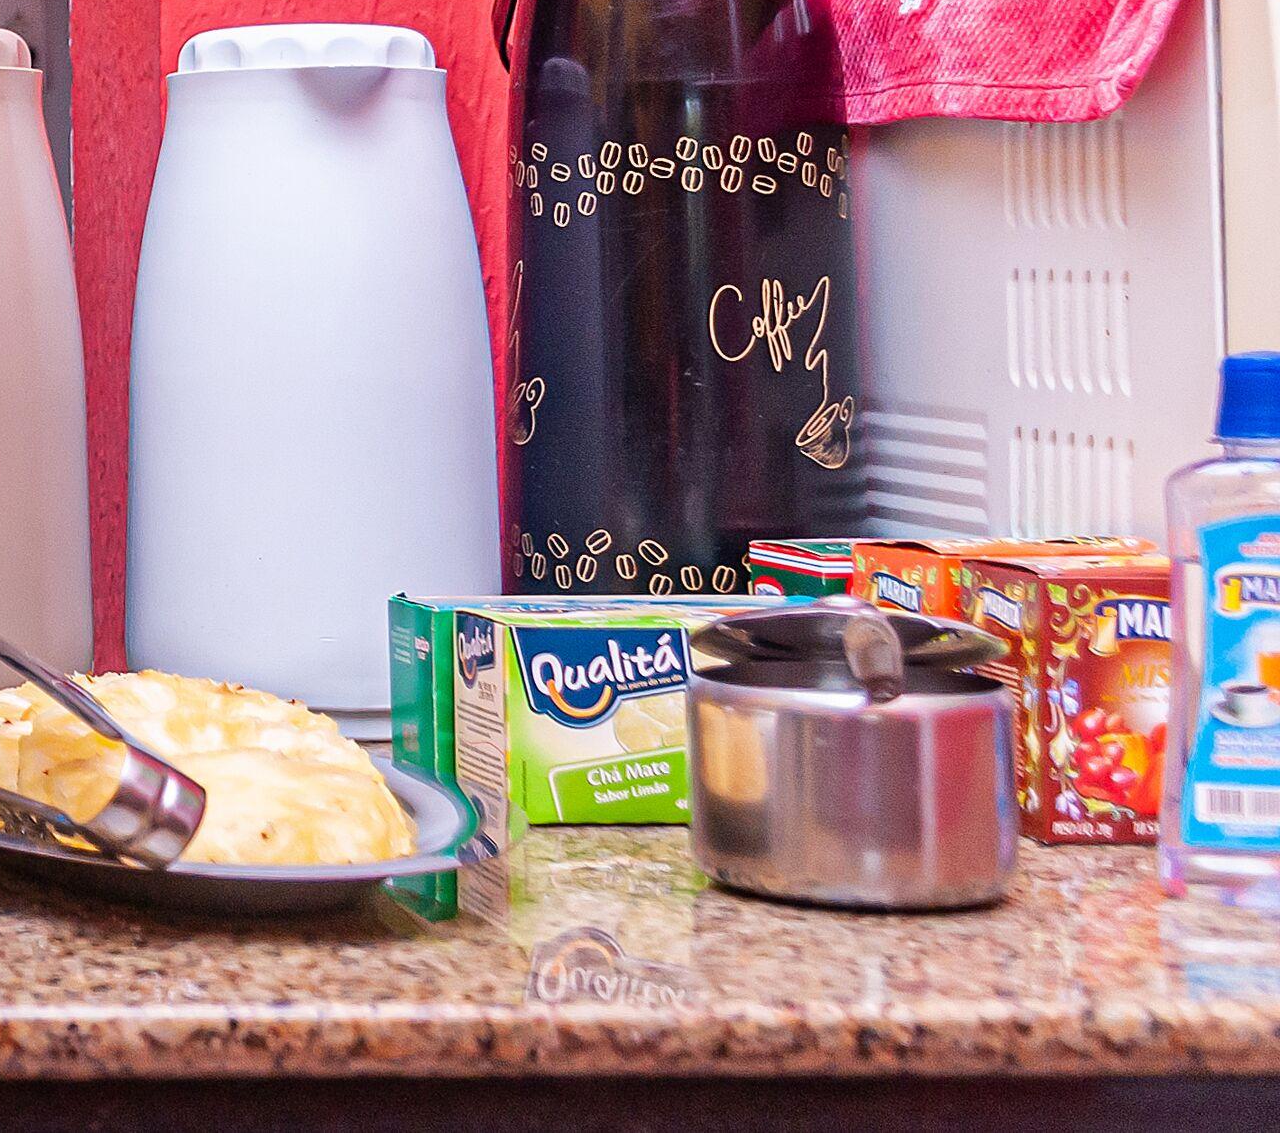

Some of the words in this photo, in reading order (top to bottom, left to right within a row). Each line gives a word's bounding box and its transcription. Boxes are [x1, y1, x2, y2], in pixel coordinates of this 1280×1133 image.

[709, 278, 814, 372] Coffee
[531, 632, 682, 697] Qualitá
[586, 764, 622, 786] Chá
[625, 761, 670, 781] Mate
[593, 789, 629, 804] Sabor
[630, 781, 670, 798] Limão
